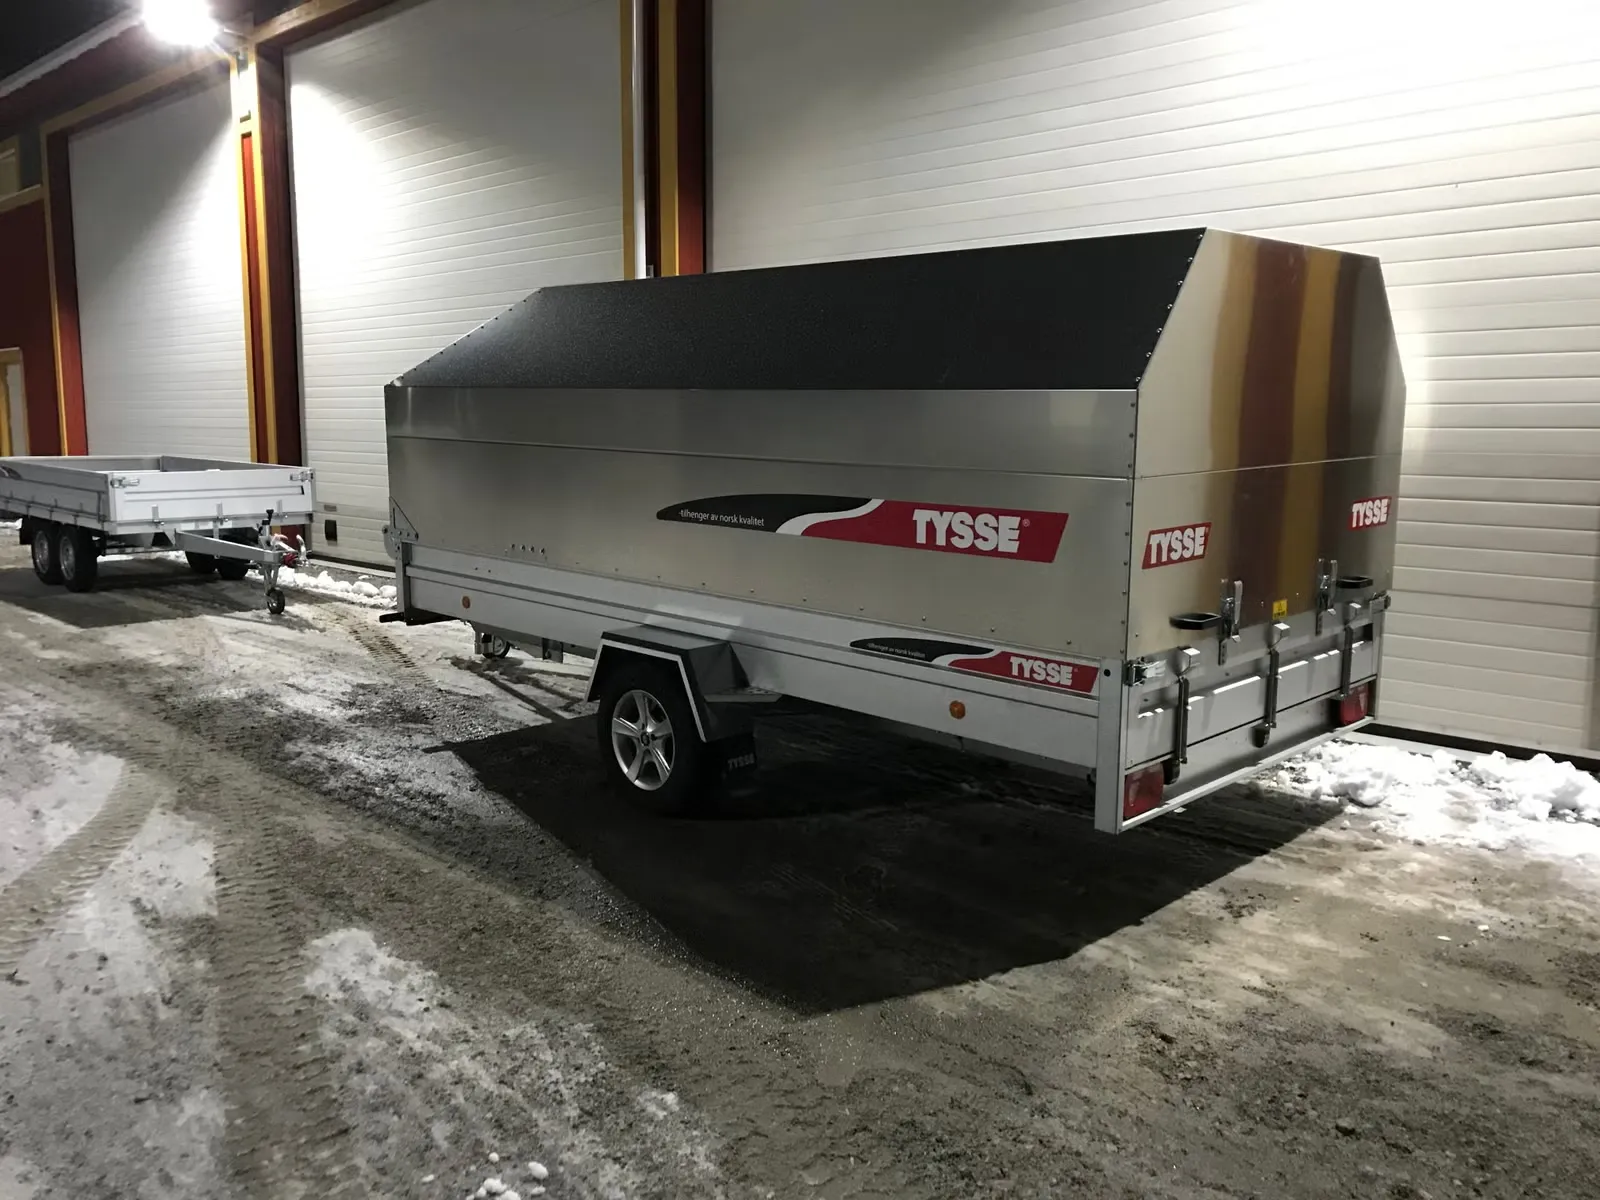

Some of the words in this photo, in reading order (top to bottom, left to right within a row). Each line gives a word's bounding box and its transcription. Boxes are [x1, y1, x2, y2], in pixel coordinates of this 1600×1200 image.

[719, 514, 739, 524] norsk
[739, 514, 765, 527] kvalitet
[1351, 498, 1389, 528] TYSSE
[912, 509, 1021, 553] TYSSE
[1150, 527, 1206, 564] TYSSE
[1010, 656, 1073, 686] TYSSE
